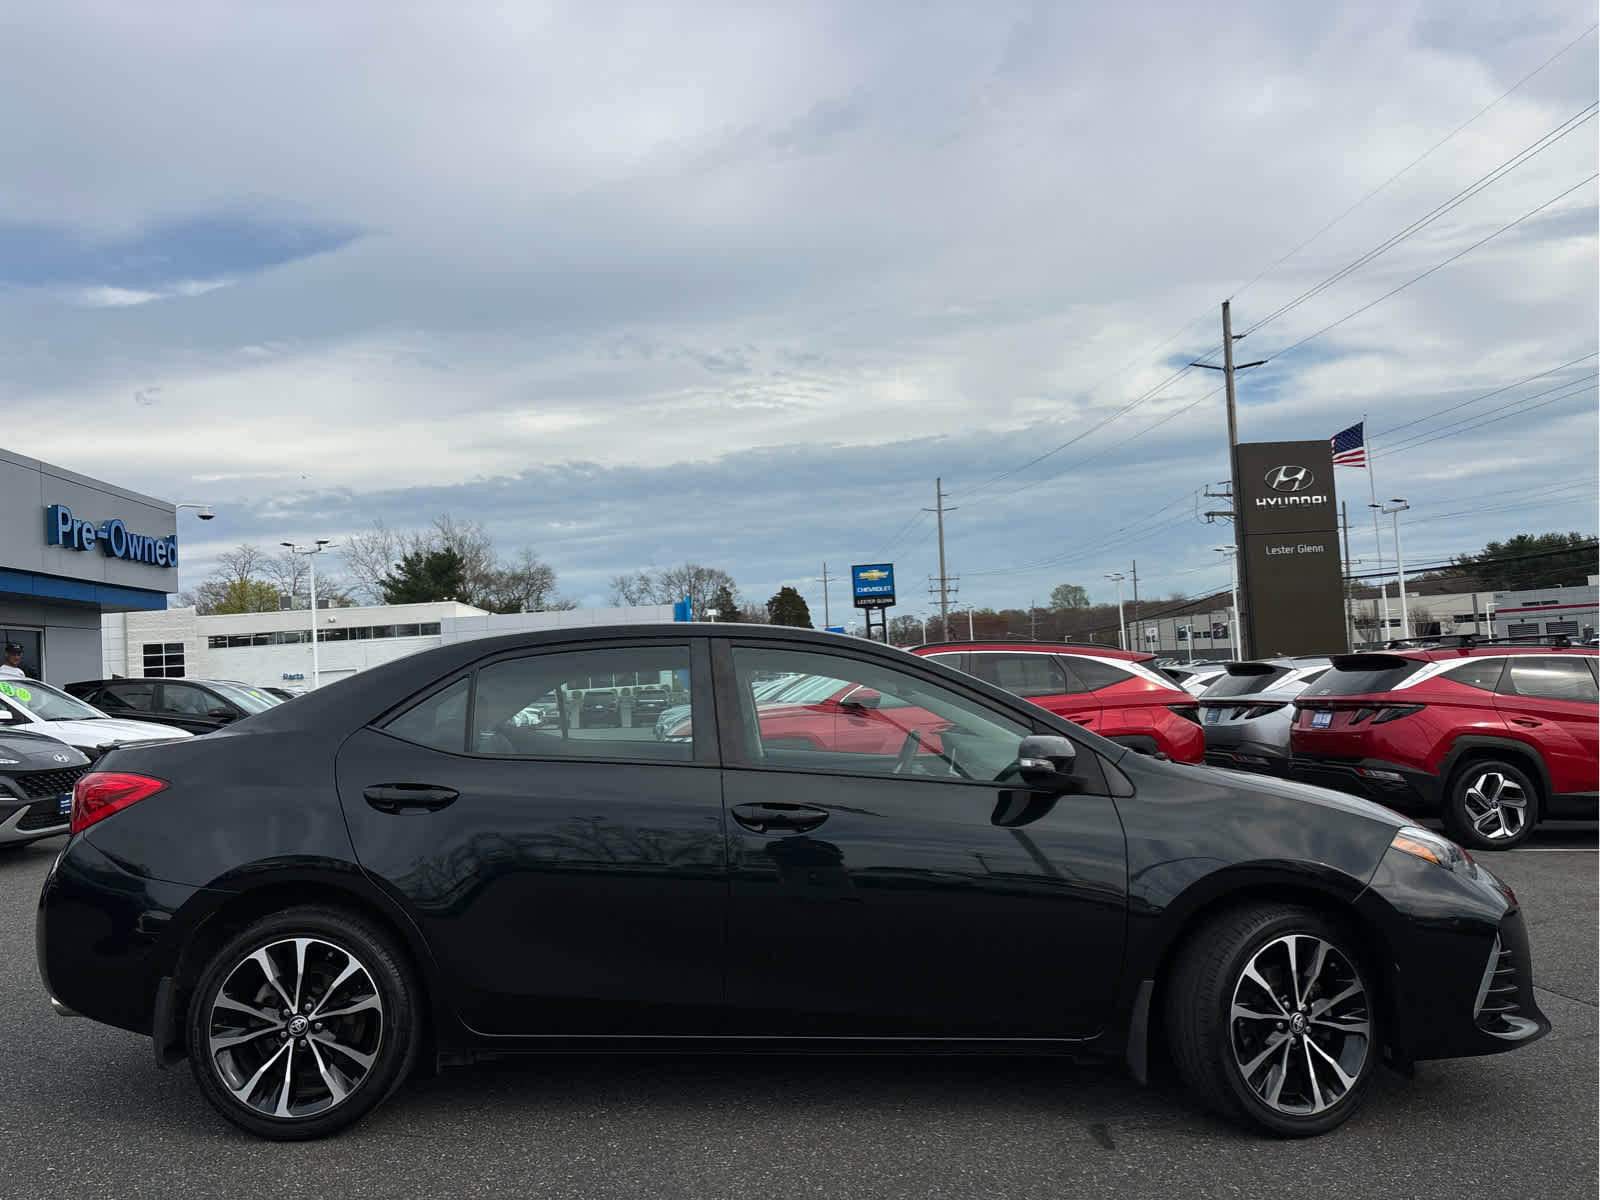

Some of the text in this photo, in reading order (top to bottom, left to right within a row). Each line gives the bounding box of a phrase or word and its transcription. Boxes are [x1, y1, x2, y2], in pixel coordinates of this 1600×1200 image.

[1255, 495, 1327, 507] HYUNDAI
[48, 504, 178, 568] Pre-Owned
[1265, 544, 1324, 555] Lester Glenn
